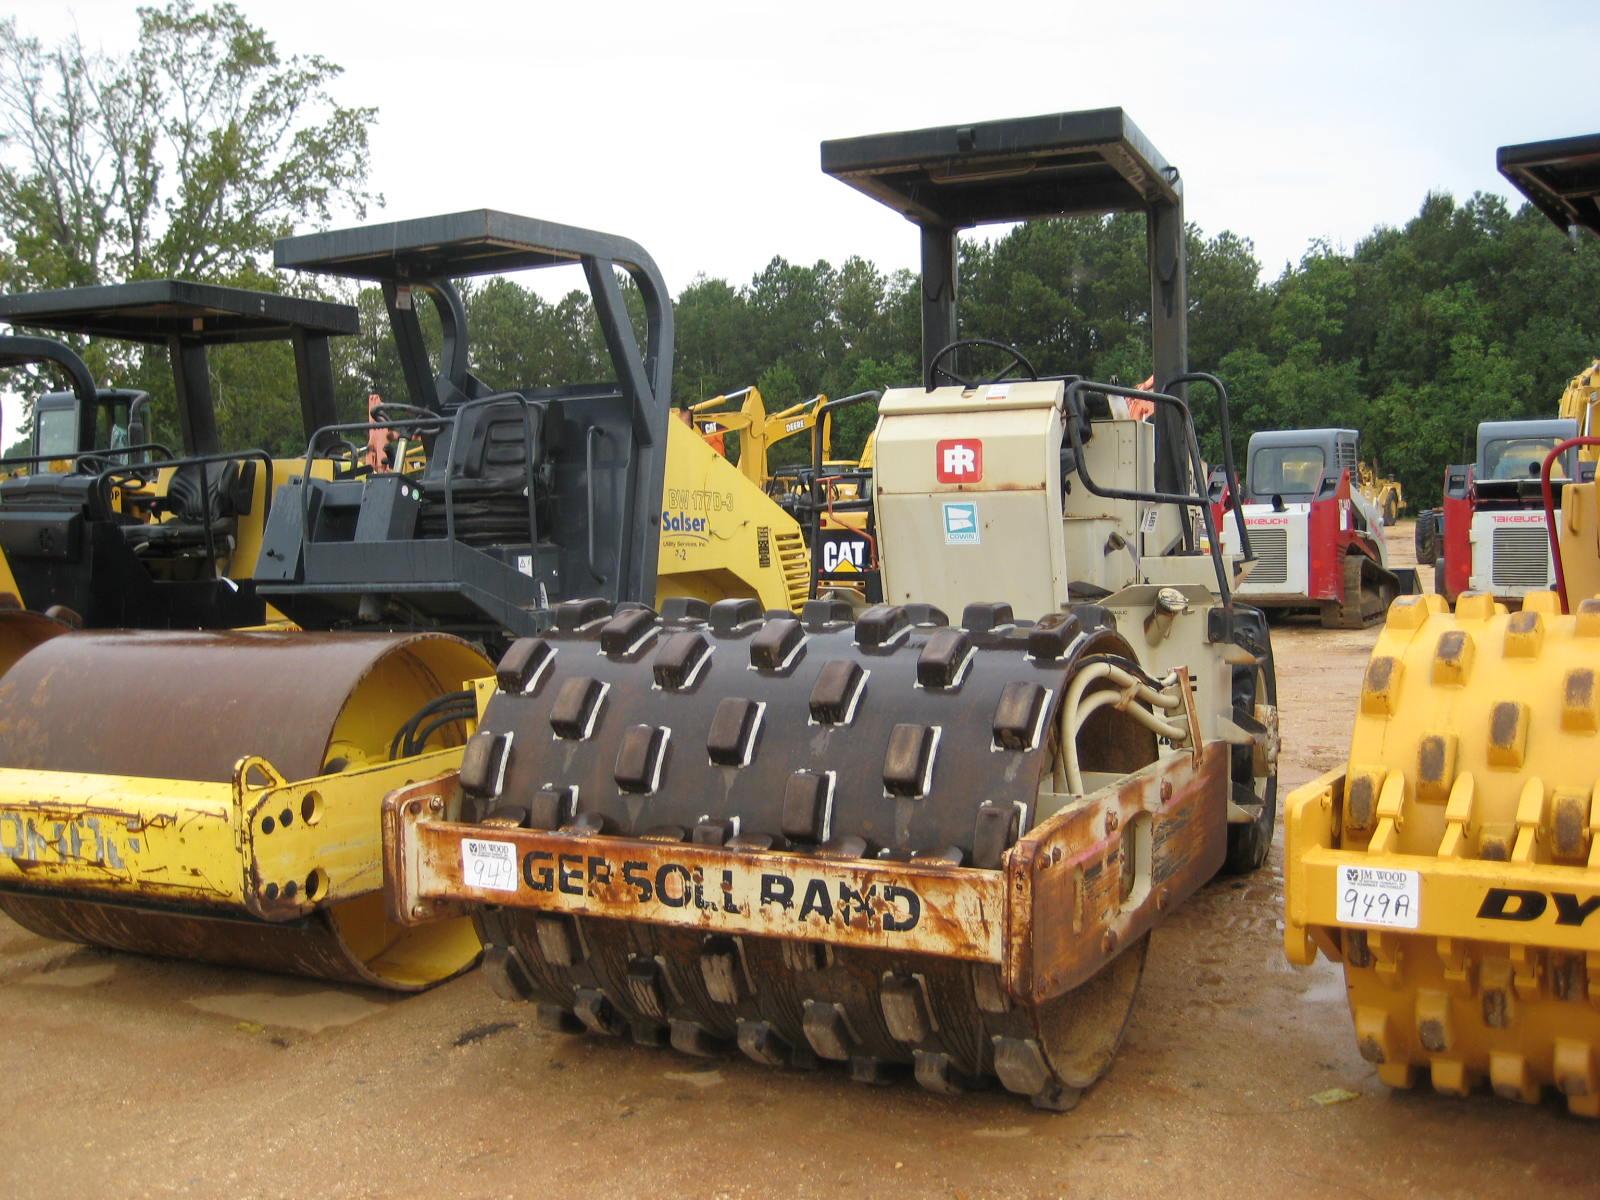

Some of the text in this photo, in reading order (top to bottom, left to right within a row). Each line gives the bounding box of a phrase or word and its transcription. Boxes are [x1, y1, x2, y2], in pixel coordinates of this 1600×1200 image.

[705, 422, 716, 434] CAT
[786, 420, 804, 433] DEERE
[668, 489, 688, 510] BW
[1243, 518, 1288, 526] AKEUCHI
[1491, 515, 1546, 523] TAKEUCH
[823, 541, 865, 573] CAT
[489, 844, 509, 854] WOOD
[473, 859, 513, 889] 949
[1360, 869, 1407, 882] JM WOOD
[760, 870, 921, 932] RAND
[1344, 888, 1410, 918] 949A
[1476, 887, 1600, 927] DY
